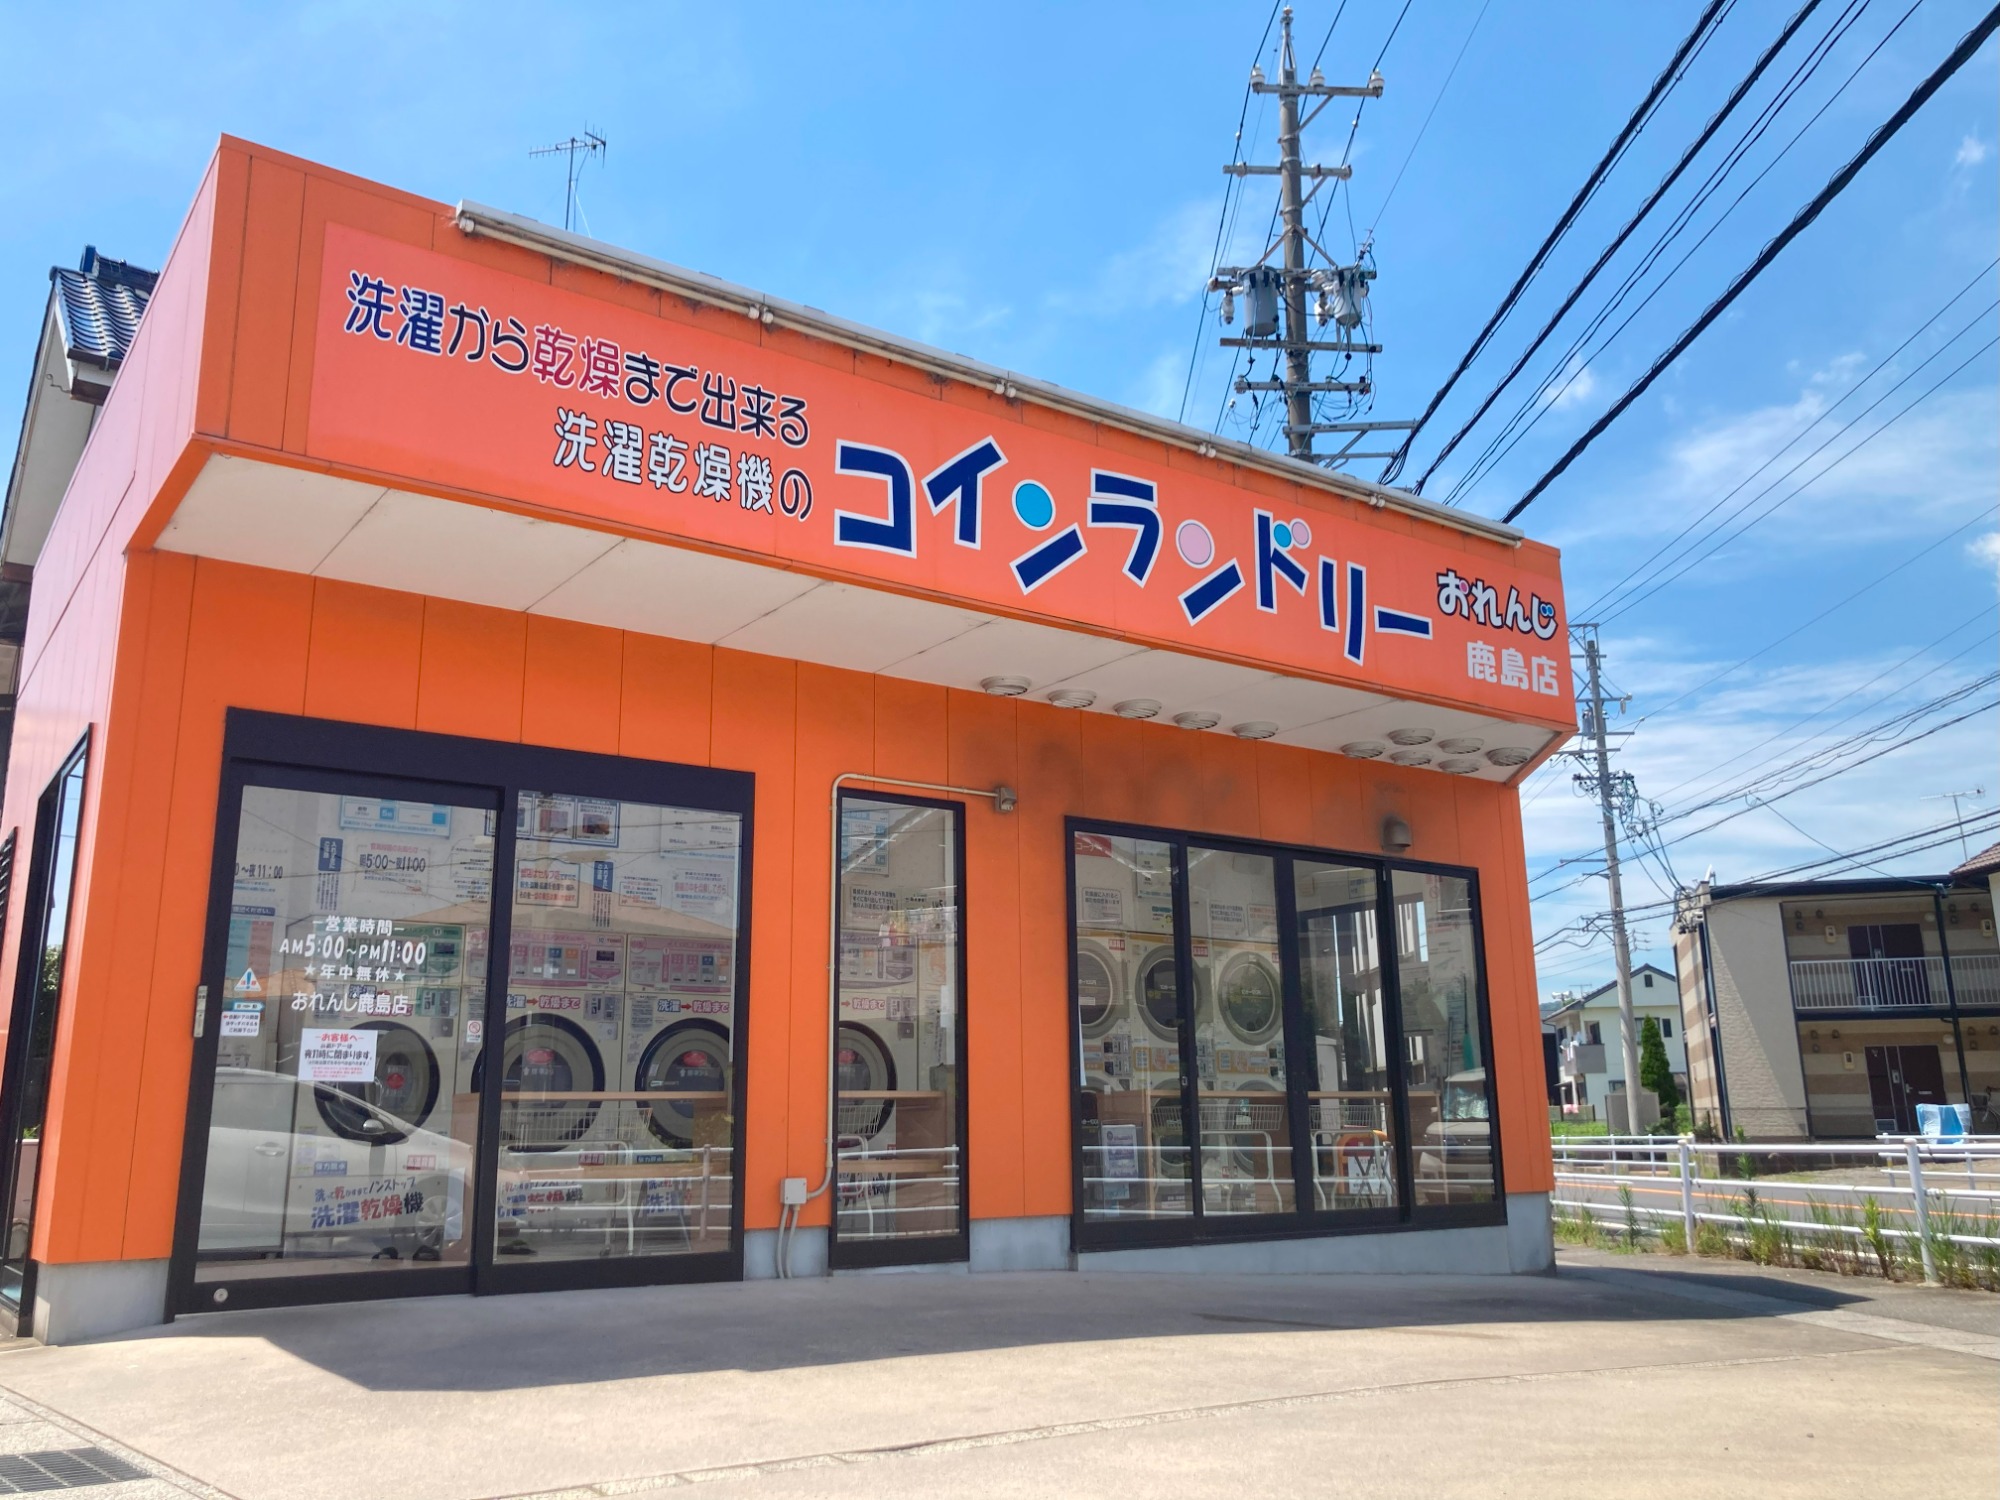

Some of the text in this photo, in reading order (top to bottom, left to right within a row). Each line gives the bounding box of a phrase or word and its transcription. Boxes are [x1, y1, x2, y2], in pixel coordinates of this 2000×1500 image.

[344, 269, 811, 448] 洗濯から乾燥まで出来る
[553, 406, 813, 521] 洗濯乾燥機の
[834, 435, 1434, 666] コインランドリー
[1436, 567, 1559, 641] おれんじ
[1466, 641, 1560, 698] 鹿島店
[325, 915, 393, 936] 営業時間
[291, 991, 409, 1014] おれんじ鹿島店
[320, 964, 390, 982] 年中無休
